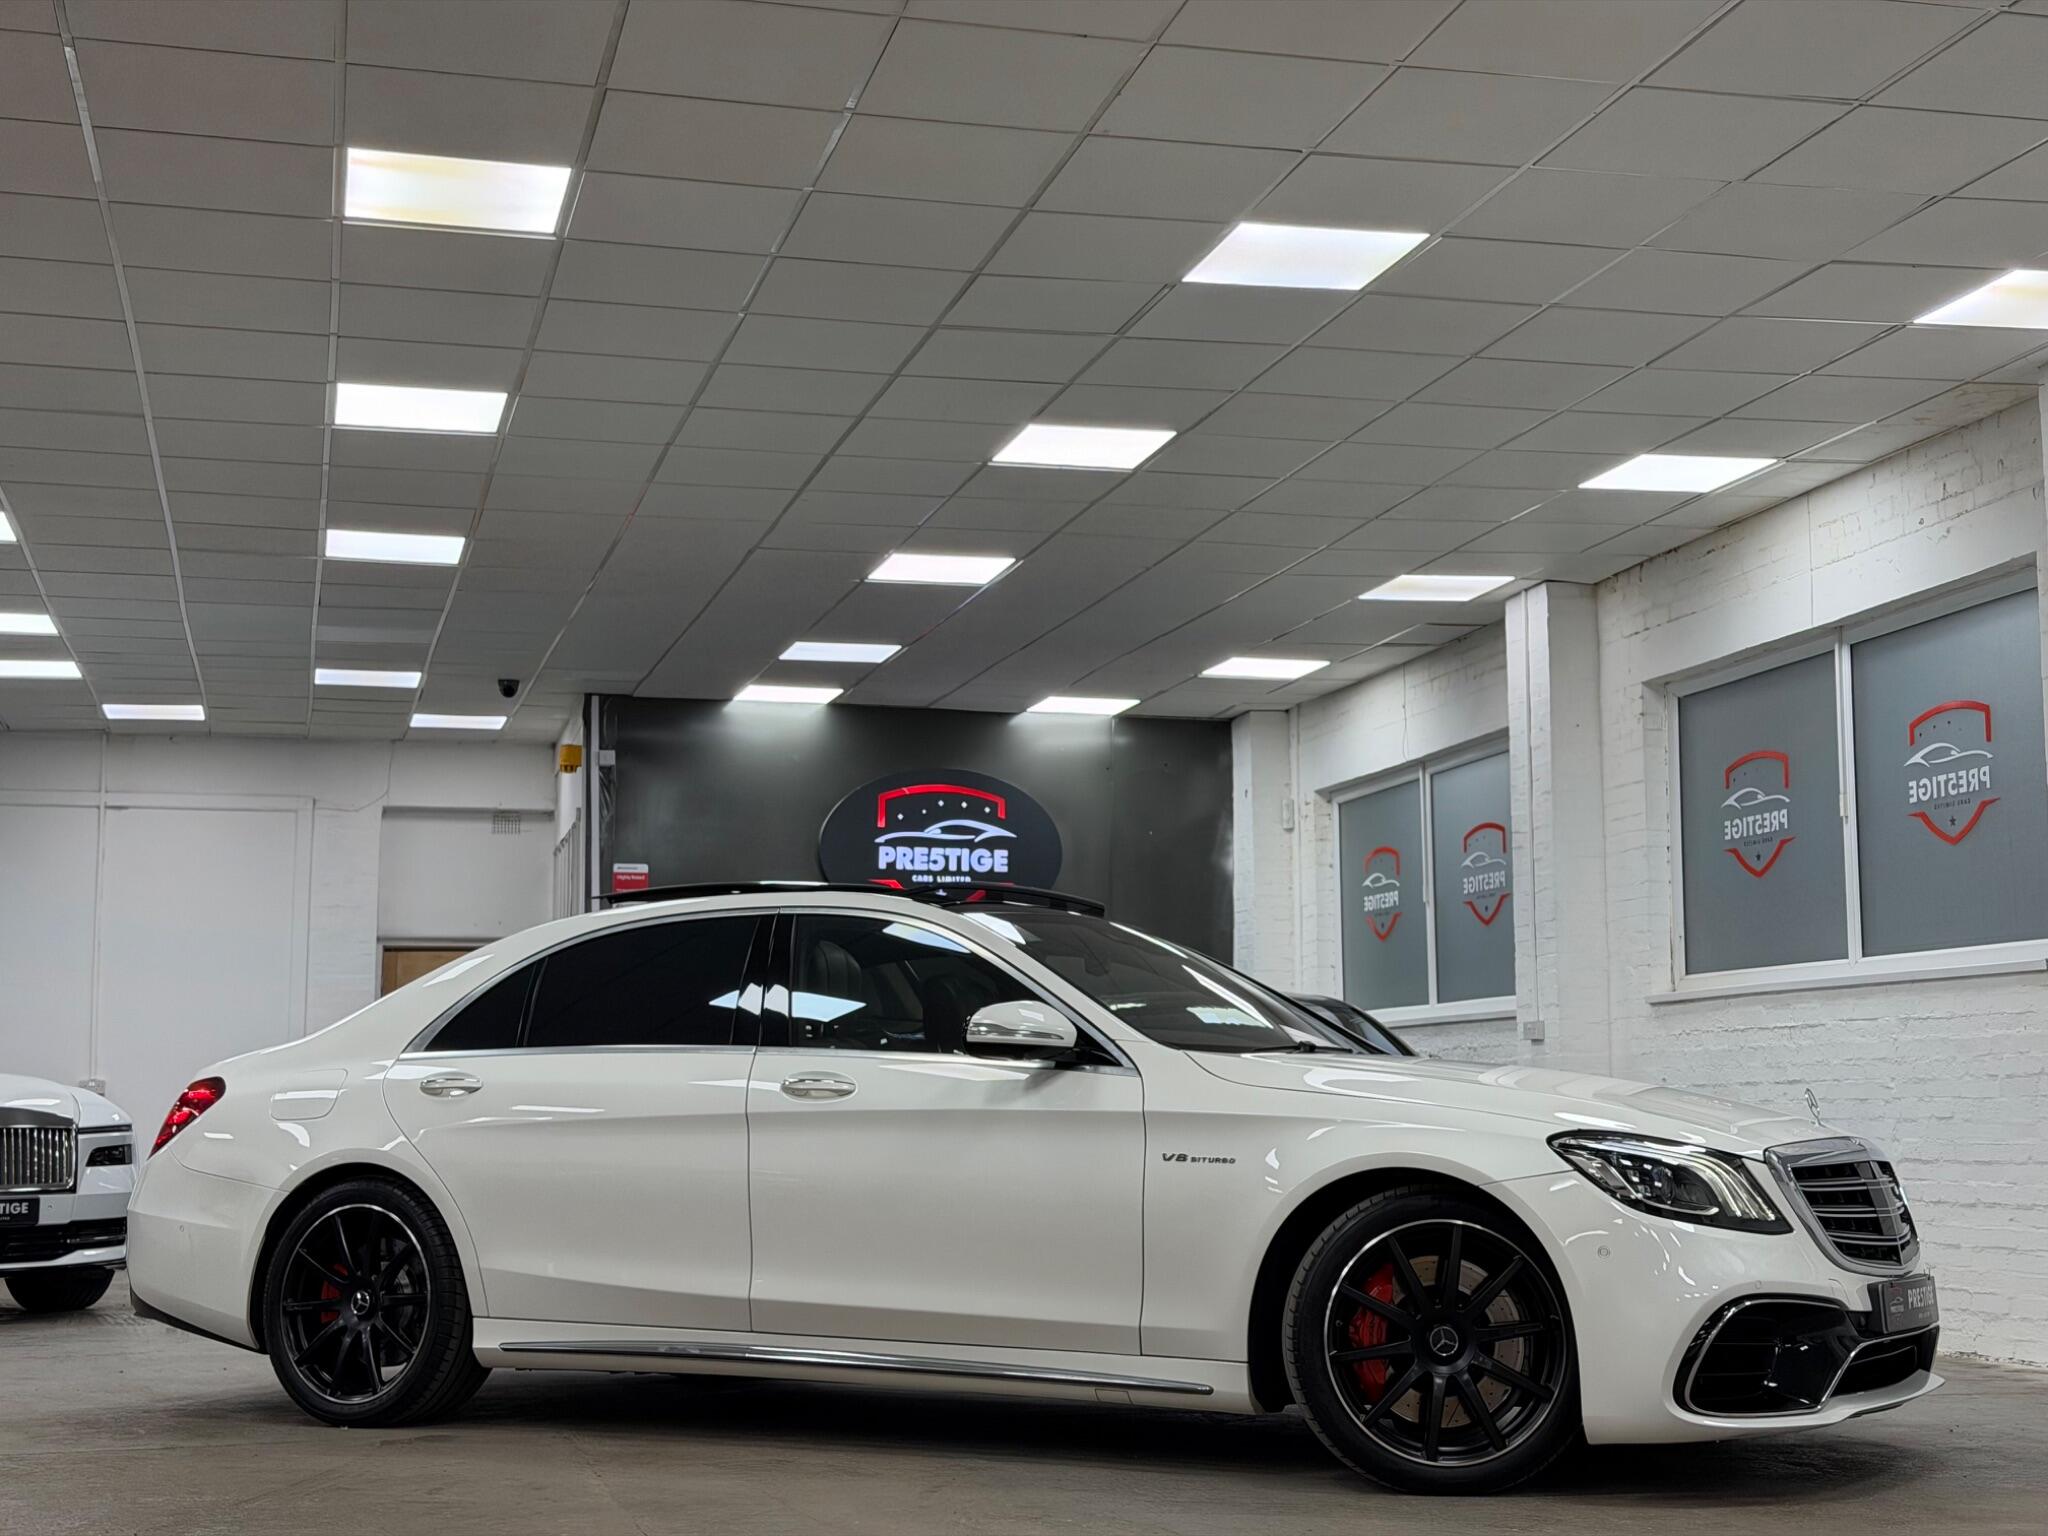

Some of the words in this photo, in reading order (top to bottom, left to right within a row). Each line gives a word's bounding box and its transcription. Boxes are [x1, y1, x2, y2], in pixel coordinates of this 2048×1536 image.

[911, 874, 934, 883] CARS
[1162, 1152, 1189, 1162] V8
[1190, 1156, 1236, 1164] BITURBO
